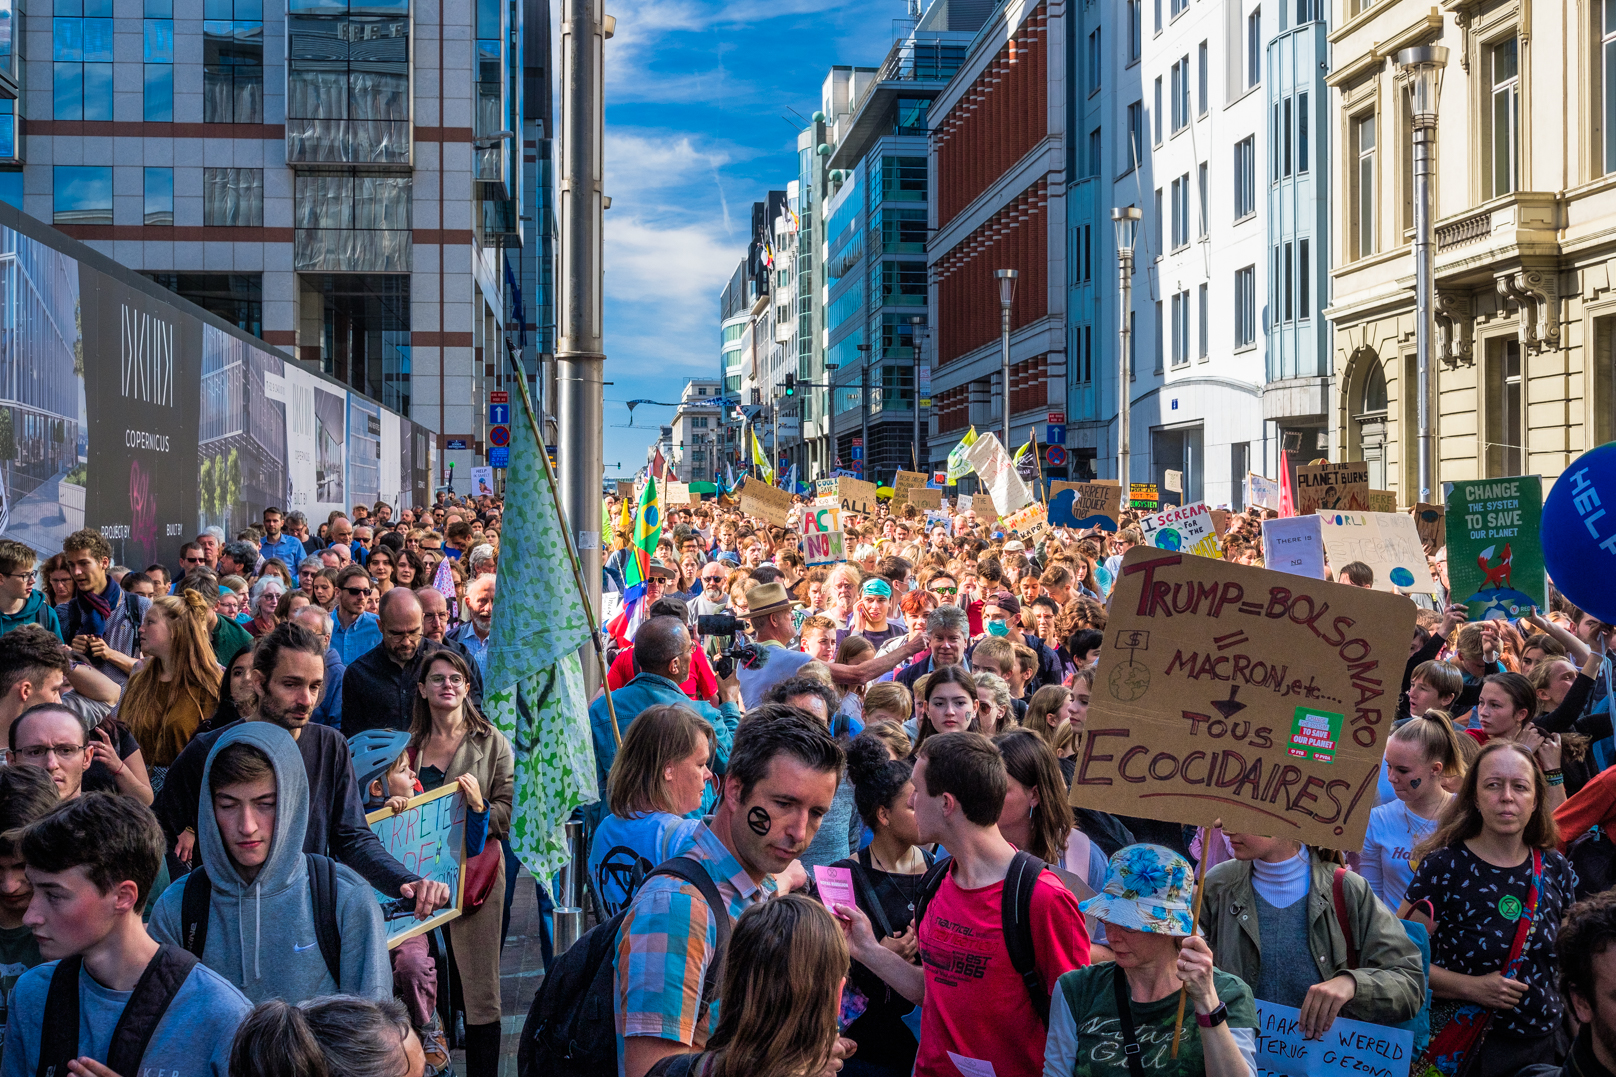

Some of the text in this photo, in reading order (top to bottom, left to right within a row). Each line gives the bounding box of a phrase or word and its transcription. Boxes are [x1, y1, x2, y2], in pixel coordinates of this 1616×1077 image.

[126, 429, 170, 452] COPERNICUS
[1321, 462, 1349, 472] IF THE
[1298, 471, 1368, 488] PLANET BURNS
[1078, 485, 1111, 500] ARRETE
[1465, 482, 1520, 501] CHANGE
[841, 498, 871, 515] ALL
[1075, 497, 1107, 511] NIQUER
[1468, 499, 1519, 512] THE SYSTEM
[804, 507, 841, 534] ACT
[1141, 504, 1209, 533] I SCREAM
[1183, 520, 1198, 529] FOR
[1320, 514, 1367, 526] WORLD
[1465, 510, 1522, 529] TO SAVE
[1019, 521, 1044, 540] KAPOT
[1188, 526, 1204, 536] THE
[1470, 527, 1519, 539] OUR PLANET
[807, 532, 843, 559] NOW
[1276, 536, 1302, 545] THERE
[1291, 558, 1302, 566] NO
[1122, 555, 1244, 618] TRUMP
[1266, 586, 1384, 748] BOLSONARO
[1181, 710, 1274, 749] TOUS
[1303, 727, 1328, 739] TO SAVE
[1293, 735, 1333, 749] OUR PLANET
[1076, 728, 1380, 836] ECOCIDAIRES!
[951, 959, 987, 979] 1966
[1255, 1035, 1309, 1059] TERUG
[1338, 1031, 1403, 1061] WERELD
